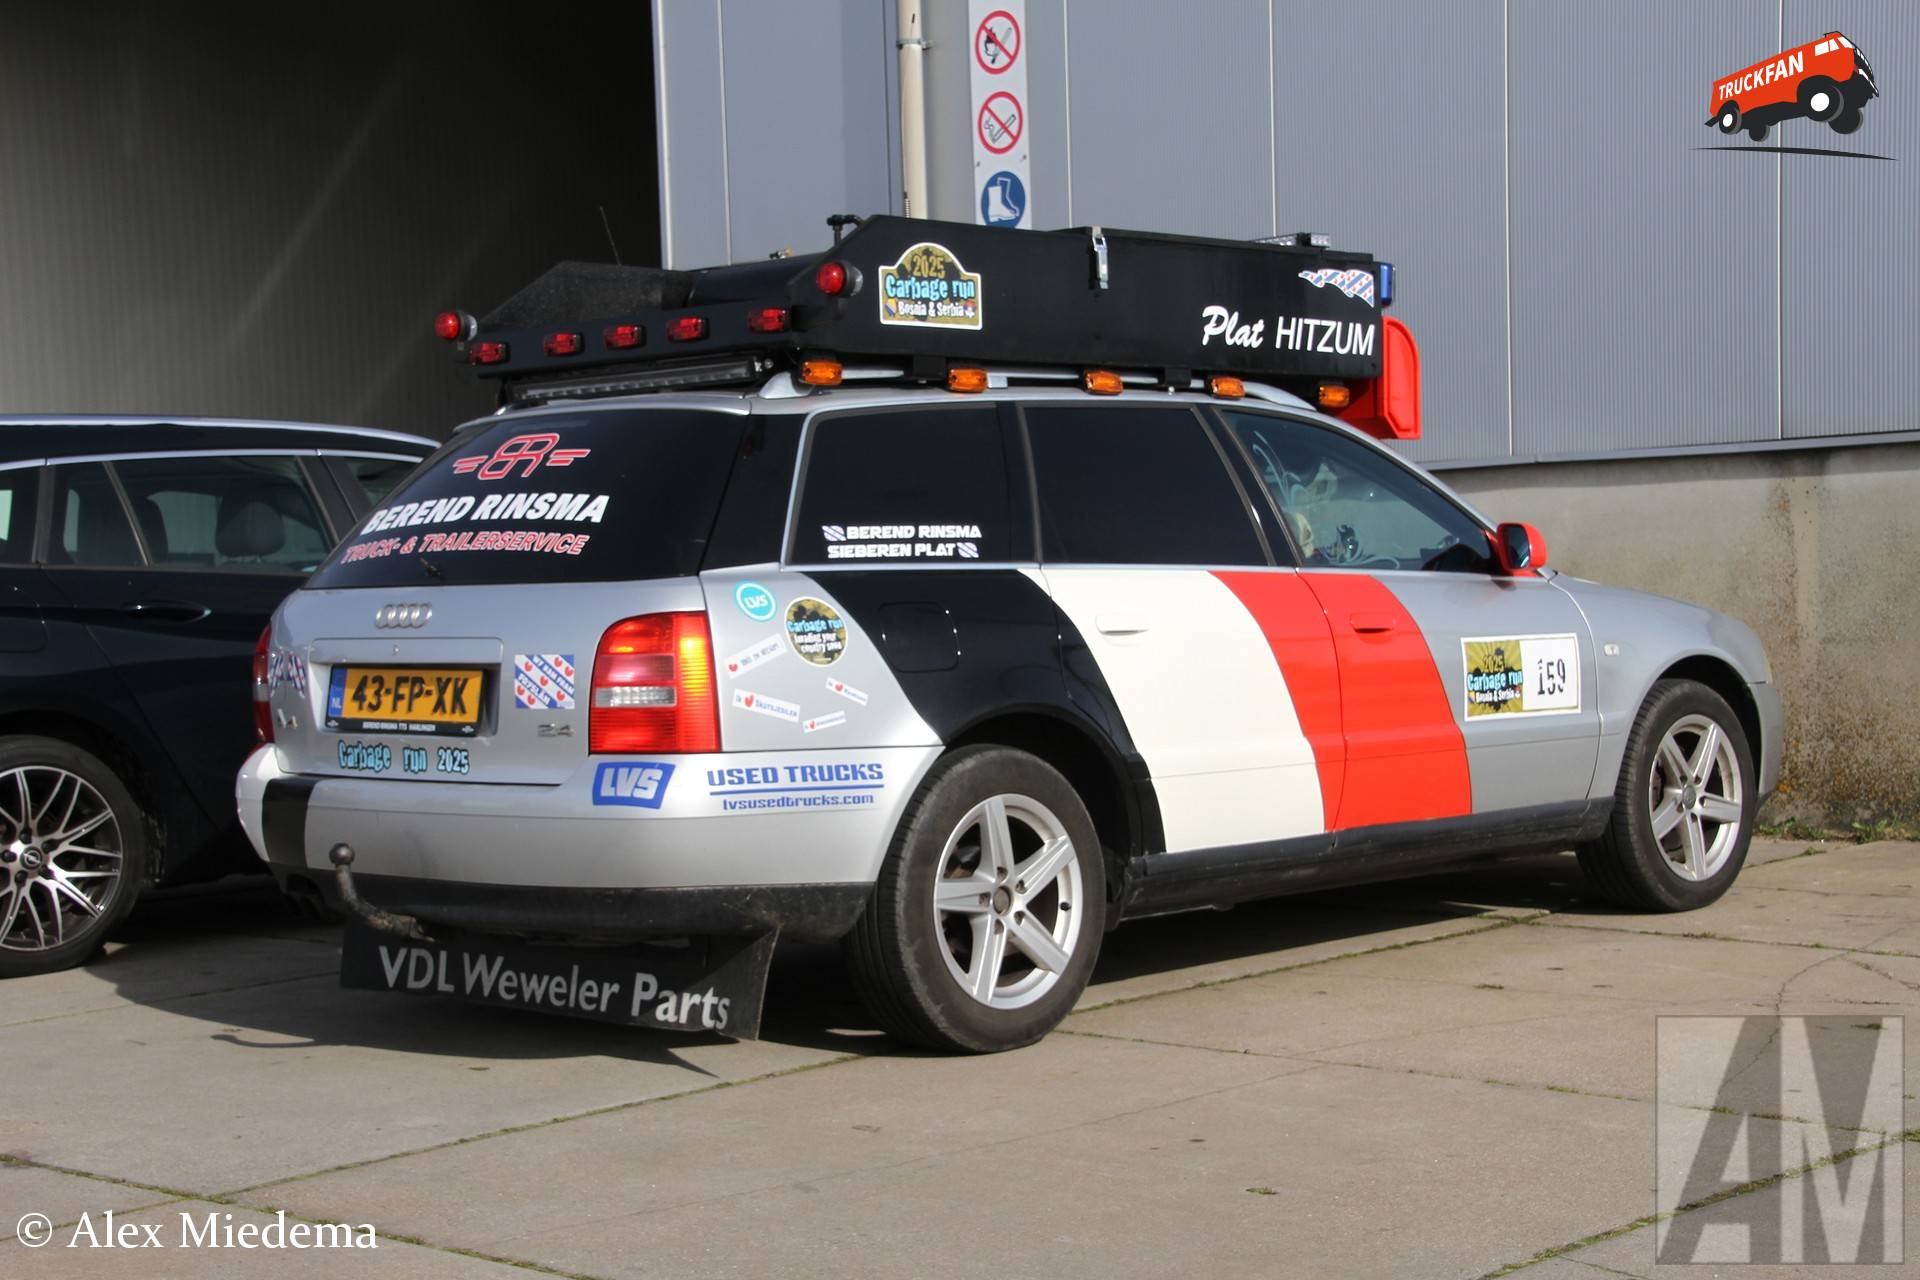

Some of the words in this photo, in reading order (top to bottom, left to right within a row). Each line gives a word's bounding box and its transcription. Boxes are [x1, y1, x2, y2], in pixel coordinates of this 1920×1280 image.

[912, 255, 946, 279] 2025
[885, 274, 948, 301] Carbage
[952, 280, 976, 299] run
[898, 301, 927, 316] Bosnia
[928, 302, 936, 317] &
[937, 302, 964, 317] Serbia
[1202, 305, 1265, 349] Plat
[1275, 316, 1375, 356] HITZUM
[360, 495, 475, 535] BEREND
[471, 492, 611, 524] RINSMA
[847, 525, 916, 540] BEREND
[918, 525, 982, 539] RINSMA
[340, 536, 400, 564] TRUCK-
[400, 535, 415, 554] &
[418, 531, 591, 555] TRAILERSERVICE
[827, 543, 912, 559] SIEBEREN
[914, 543, 957, 557] PLAT
[744, 594, 769, 609] LVS
[786, 619, 828, 633] Carbage
[1483, 656, 1504, 673] 2025
[1467, 672, 1506, 691] Carbage
[1508, 671, 1523, 685] run
[1537, 658, 1566, 695] 159
[332, 697, 341, 709] NL
[351, 673, 470, 715] 43-FP-XK
[338, 740, 391, 773] Carbage
[403, 746, 427, 773] run
[437, 747, 470, 774] 2025
[600, 768, 663, 800] LVS
[707, 766, 779, 786] USED
[784, 763, 884, 783] TRUCKS
[723, 794, 874, 811] lvsusedtrucks.com
[378, 945, 456, 993] VDL
[462, 952, 620, 1013] Weweler
[631, 972, 731, 1030] Parts
